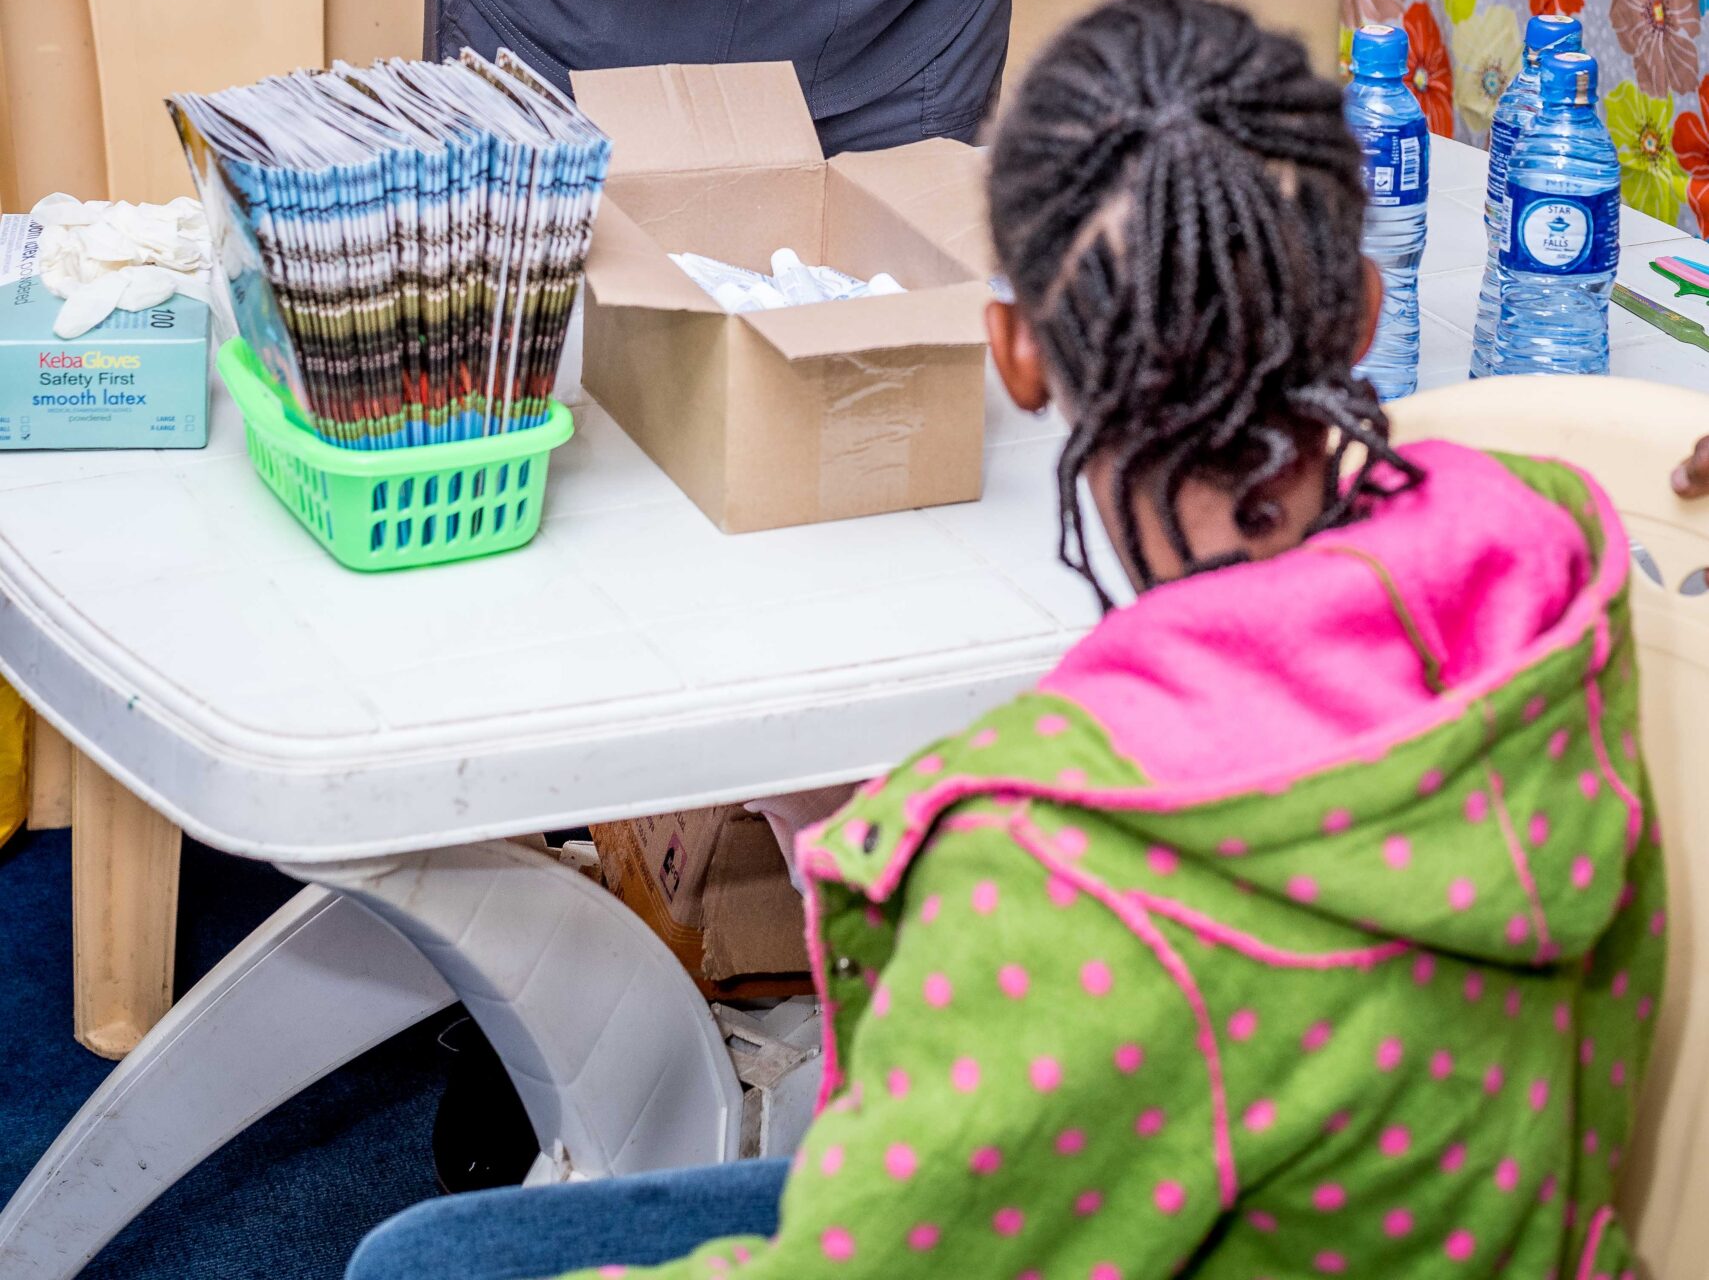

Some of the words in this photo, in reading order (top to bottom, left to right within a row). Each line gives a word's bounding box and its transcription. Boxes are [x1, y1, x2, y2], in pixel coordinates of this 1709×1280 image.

[1548, 205, 1571, 215] STAR
[21, 241, 40, 262] latex
[1543, 239, 1569, 248] FALLS
[14, 261, 38, 306] powdered
[150, 309, 175, 329] 100
[39, 351, 142, 369] KebaGloves
[40, 372, 93, 388] Safety
[99, 372, 135, 386] First
[32, 389, 96, 406] smooth
[103, 389, 146, 406] latex
[69, 414, 112, 423] powdered
